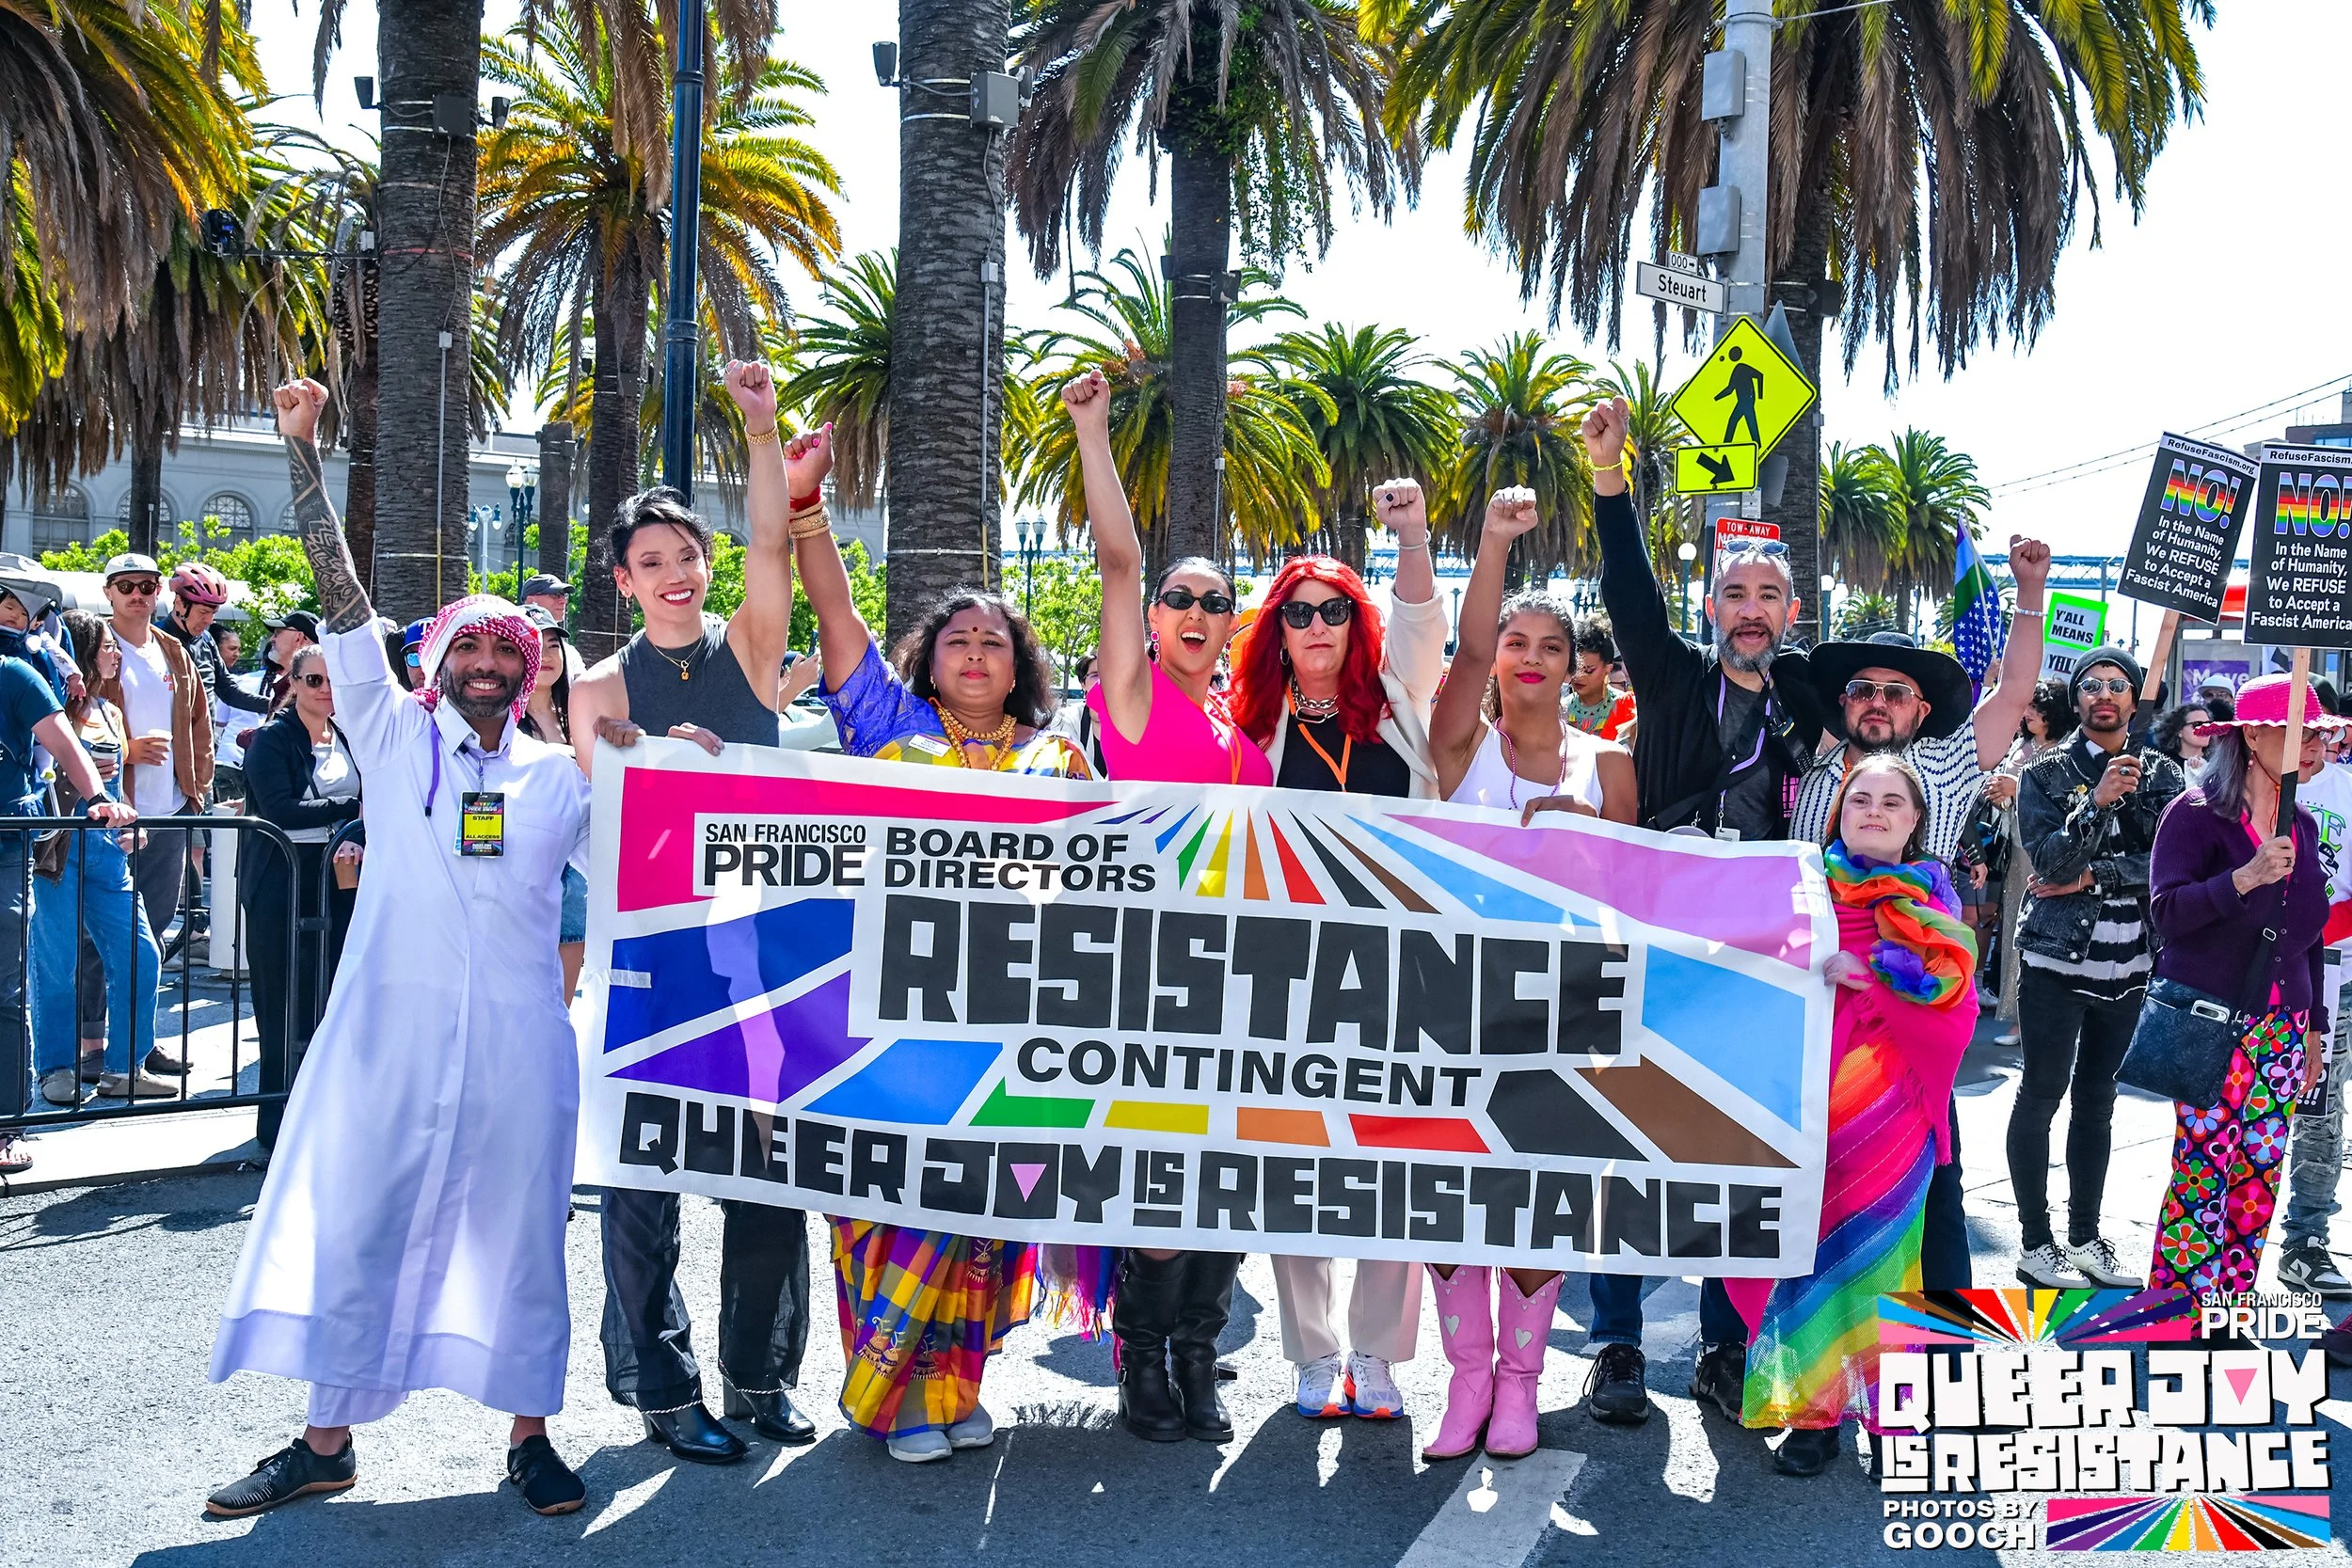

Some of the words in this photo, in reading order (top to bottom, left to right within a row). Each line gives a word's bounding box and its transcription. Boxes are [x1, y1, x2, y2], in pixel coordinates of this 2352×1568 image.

[1658, 274, 1707, 303] Steuart
[2168, 438, 2256, 475] RefuseFascism.org
[2160, 458, 2242, 529] NO!
[2274, 472, 2352, 539] NO!
[2153, 530, 2167, 540] of
[2167, 532, 2222, 561] Humanity,
[2158, 515, 2169, 528] In
[2173, 521, 2192, 534] the
[2194, 526, 2224, 546] Name
[2146, 542, 2166, 559] We
[2169, 549, 2219, 576] REFUSE
[2275, 542, 2287, 555] In
[2290, 543, 2311, 557] the
[2314, 544, 2347, 559] Name
[2145, 559, 2157, 572] to
[2159, 563, 2203, 586] Accept
[2204, 579, 2211, 589] a
[2271, 558, 2285, 571] of
[2288, 558, 2347, 578] Humanity,
[2126, 568, 2170, 592] Fascist
[2171, 583, 2218, 608] America
[2266, 576, 2289, 591] We
[2293, 578, 2346, 594] REFUSE
[2057, 610, 2084, 626] Y'ALL
[2250, 611, 2299, 628] Fascist
[2301, 614, 2352, 630] America
[2268, 595, 2282, 609] to
[2285, 595, 2330, 615] Accept
[2332, 602, 2340, 611] a
[2051, 625, 2093, 643] MEANS
[705, 822, 747, 843] SAN
[755, 824, 866, 845] FRANCISCO
[885, 826, 1054, 862] BOARD
[1065, 833, 1129, 863] OF
[704, 845, 867, 887] PRIDE
[884, 858, 1157, 894] DIRECTORS
[879, 894, 1629, 1055] RESISTANCE
[1016, 1037, 1481, 1107] CONTINGENT
[619, 1091, 907, 1204] QUEER
[920, 1137, 1122, 1224] JOY
[1133, 1149, 1184, 1228] IS
[1198, 1150, 1784, 1259] RESISTANCE
